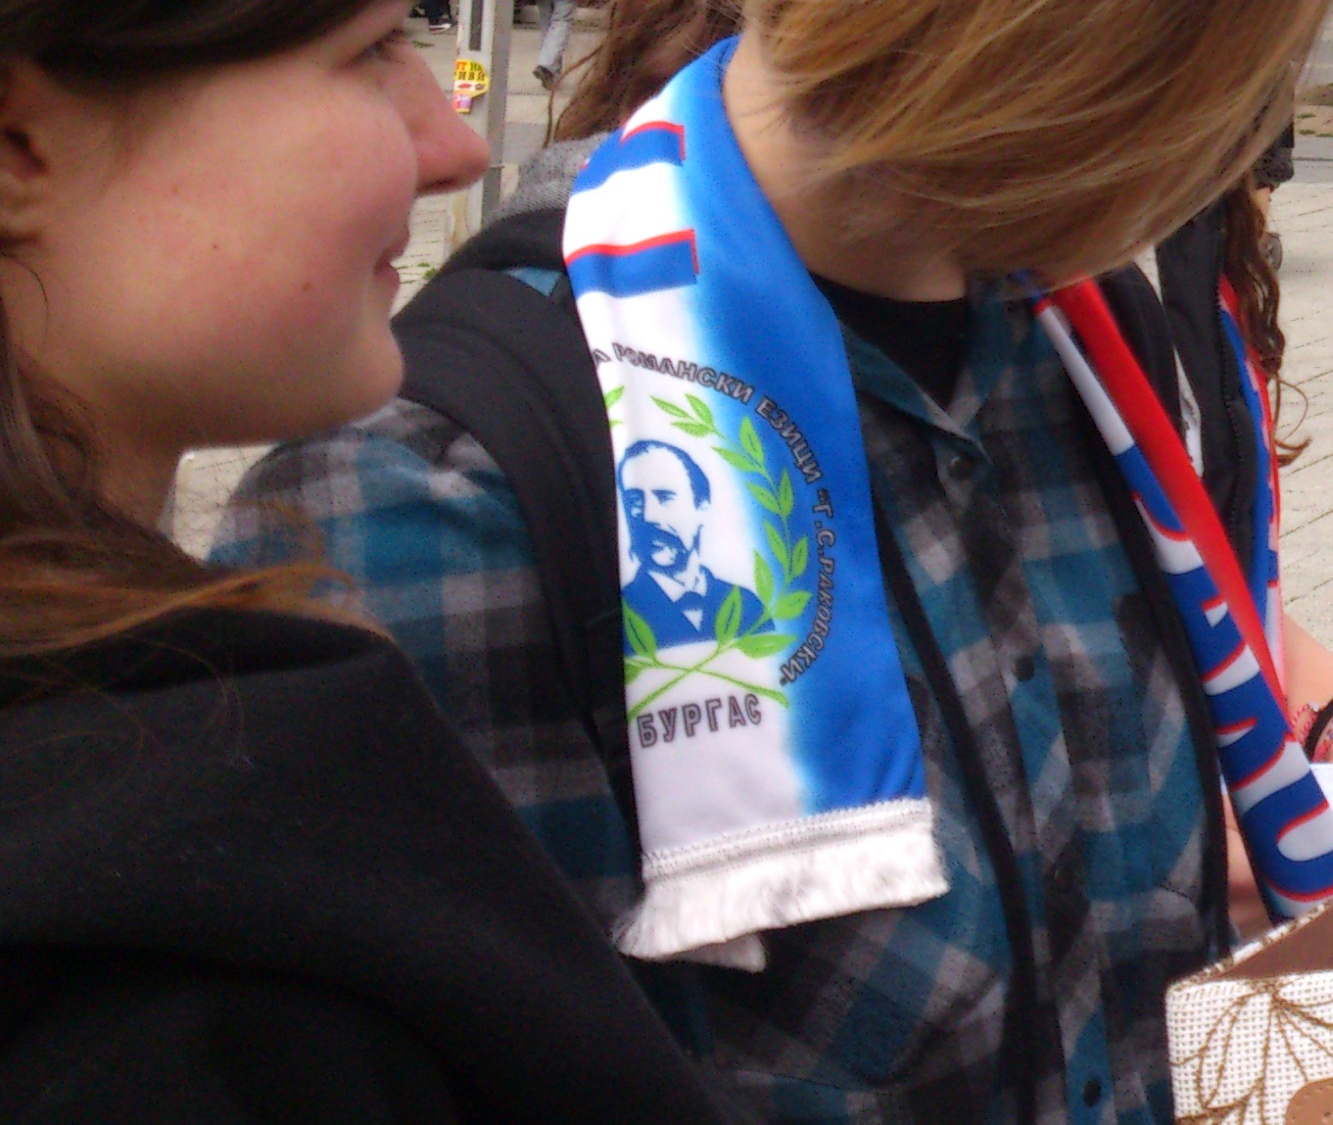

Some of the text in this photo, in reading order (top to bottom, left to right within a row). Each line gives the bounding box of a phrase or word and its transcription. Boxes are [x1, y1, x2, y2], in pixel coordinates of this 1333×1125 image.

[611, 341, 754, 405] РОМАНСКИ
[754, 395, 823, 484] ЕЗИЦИ
[636, 693, 762, 748] БУРГАС
